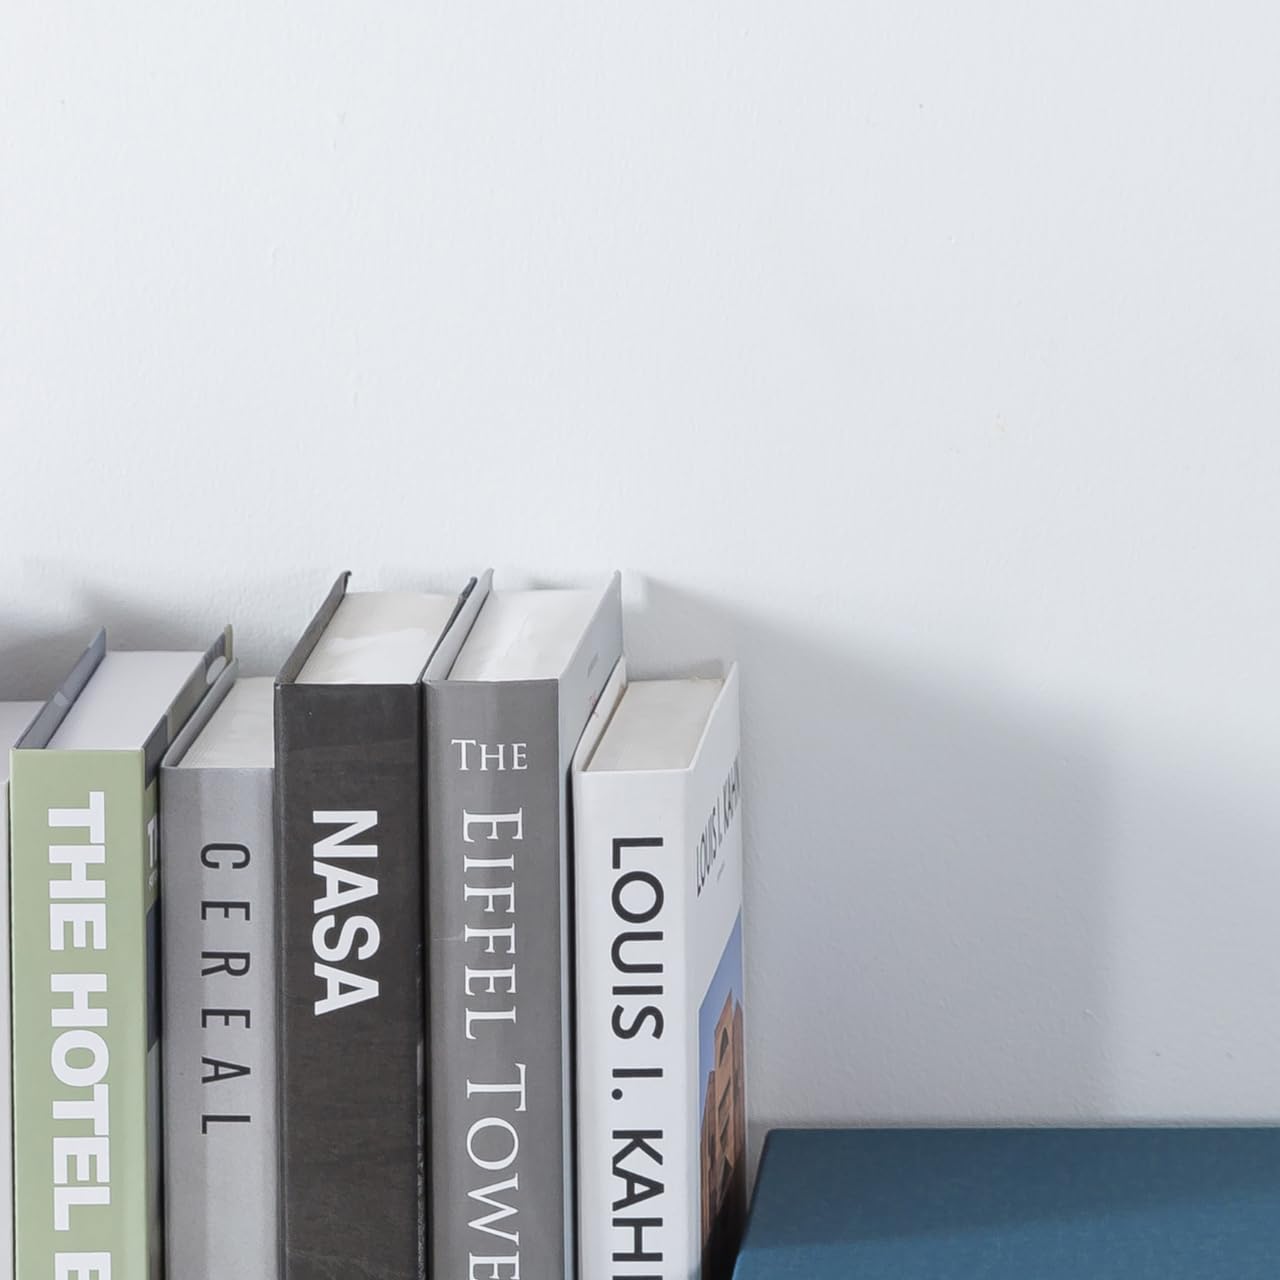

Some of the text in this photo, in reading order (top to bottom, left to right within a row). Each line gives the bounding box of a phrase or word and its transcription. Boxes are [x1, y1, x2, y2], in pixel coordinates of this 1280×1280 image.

[451, 738, 528, 771] THE
[48, 791, 106, 951] THE
[312, 810, 381, 1016] NASA
[463, 807, 522, 1040] EIFFEL
[611, 837, 664, 1040] LOUIS
[200, 843, 251, 1135] CEREAL
[611, 1068, 663, 1100] I.
[50, 973, 111, 1231] HOTEL
